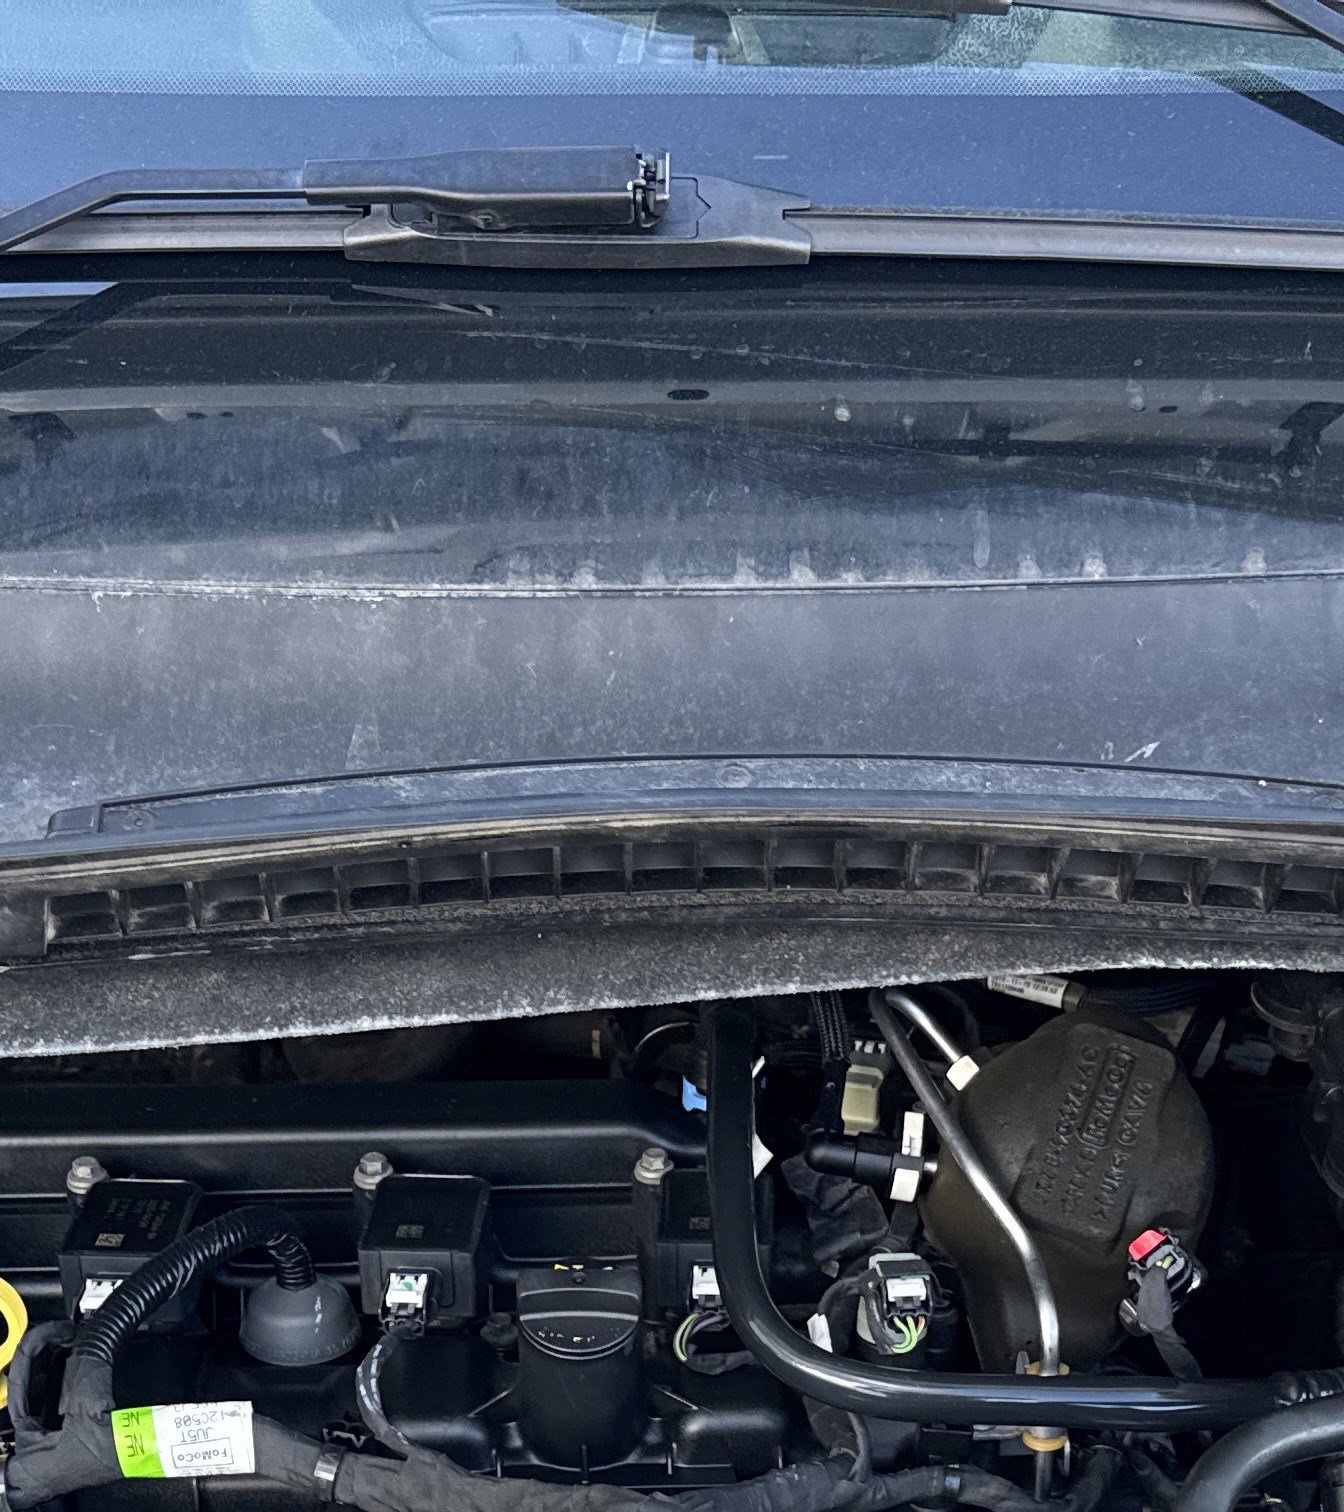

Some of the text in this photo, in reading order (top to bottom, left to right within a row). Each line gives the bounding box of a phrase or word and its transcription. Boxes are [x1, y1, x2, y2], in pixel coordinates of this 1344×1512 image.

[121, 1412, 140, 1427] NE
[124, 1434, 145, 1457] NE
[177, 1448, 227, 1462] FoMoCo
